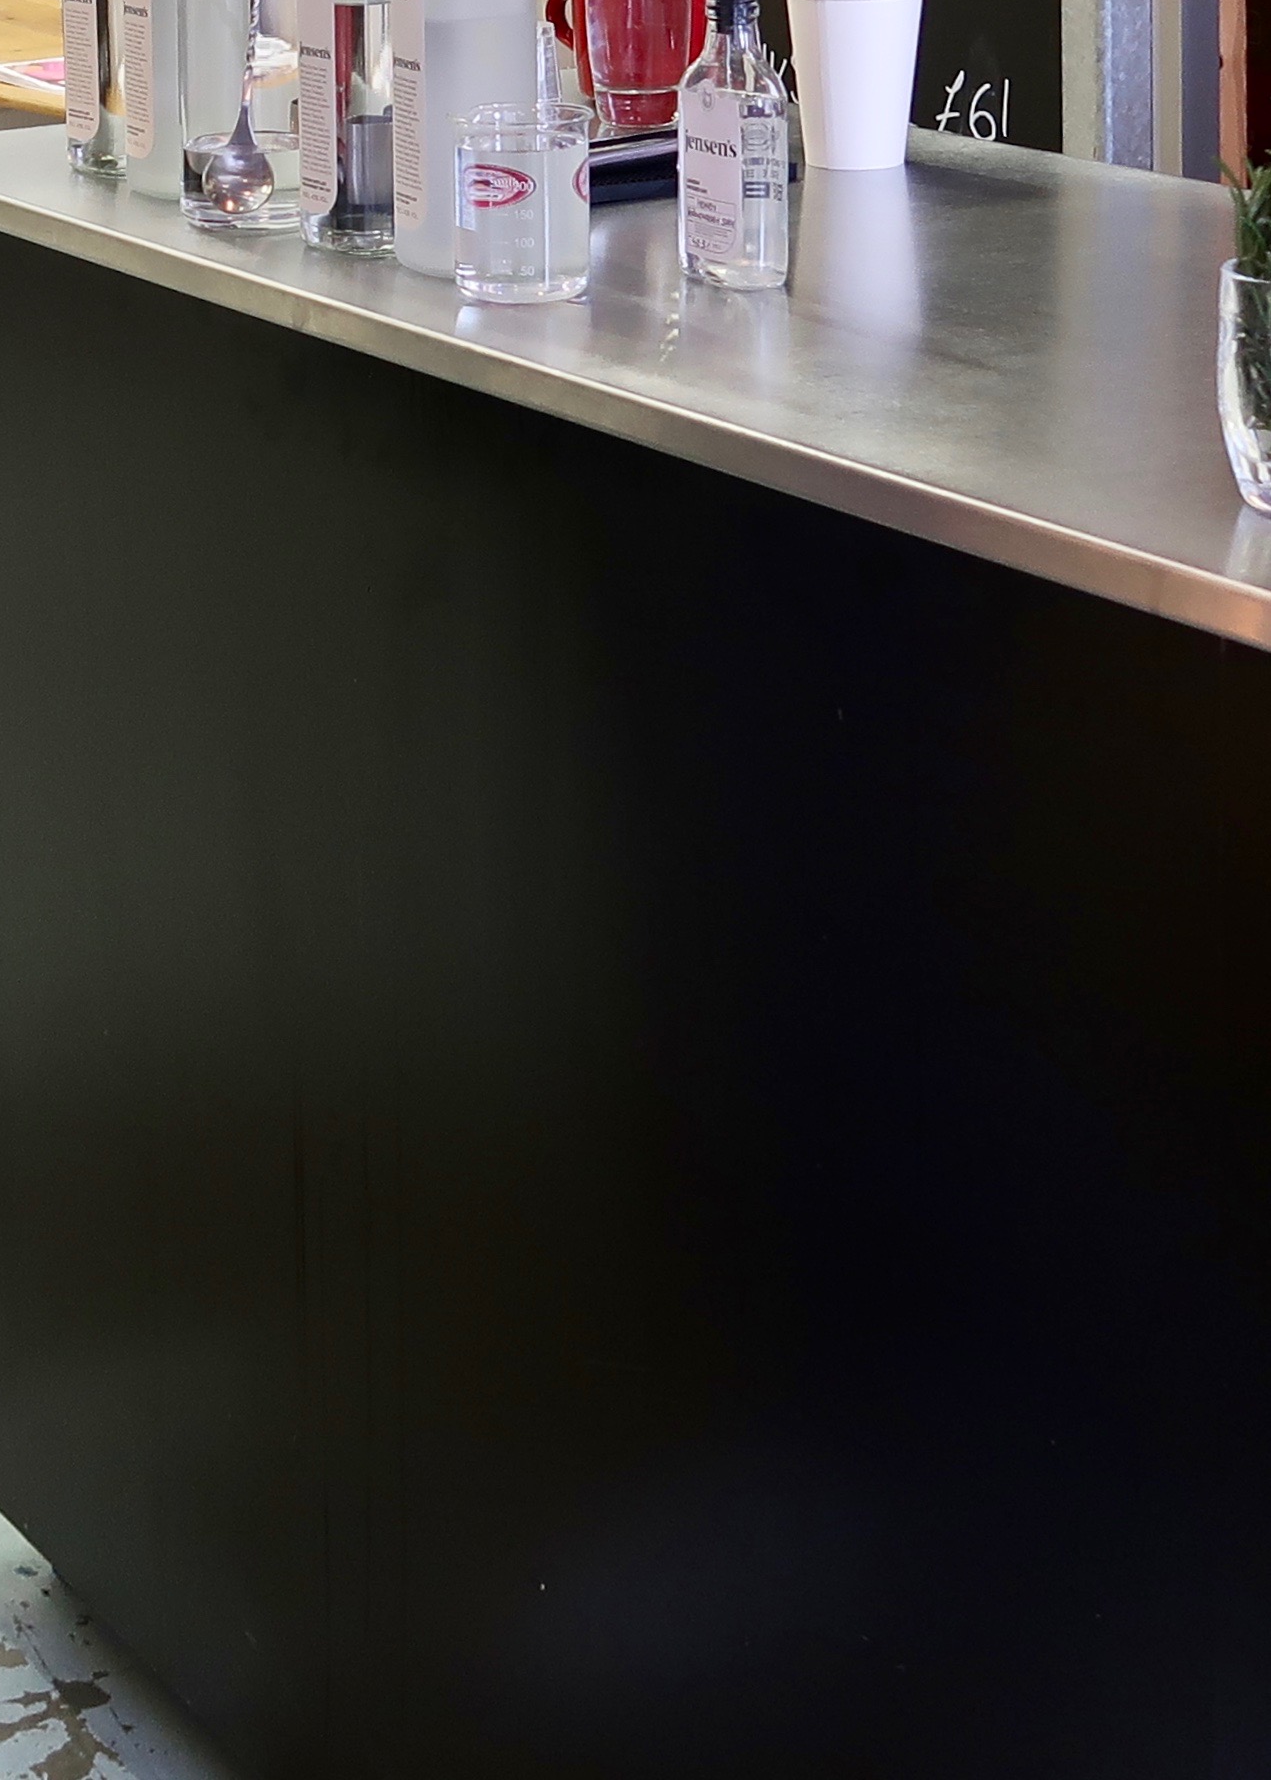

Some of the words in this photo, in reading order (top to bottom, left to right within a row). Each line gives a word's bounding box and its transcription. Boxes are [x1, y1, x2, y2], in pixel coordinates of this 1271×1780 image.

[685, 129, 737, 158] jensen's
[514, 209, 534, 220] 150
[514, 238, 535, 248] 100
[520, 265, 535, 277] 50
